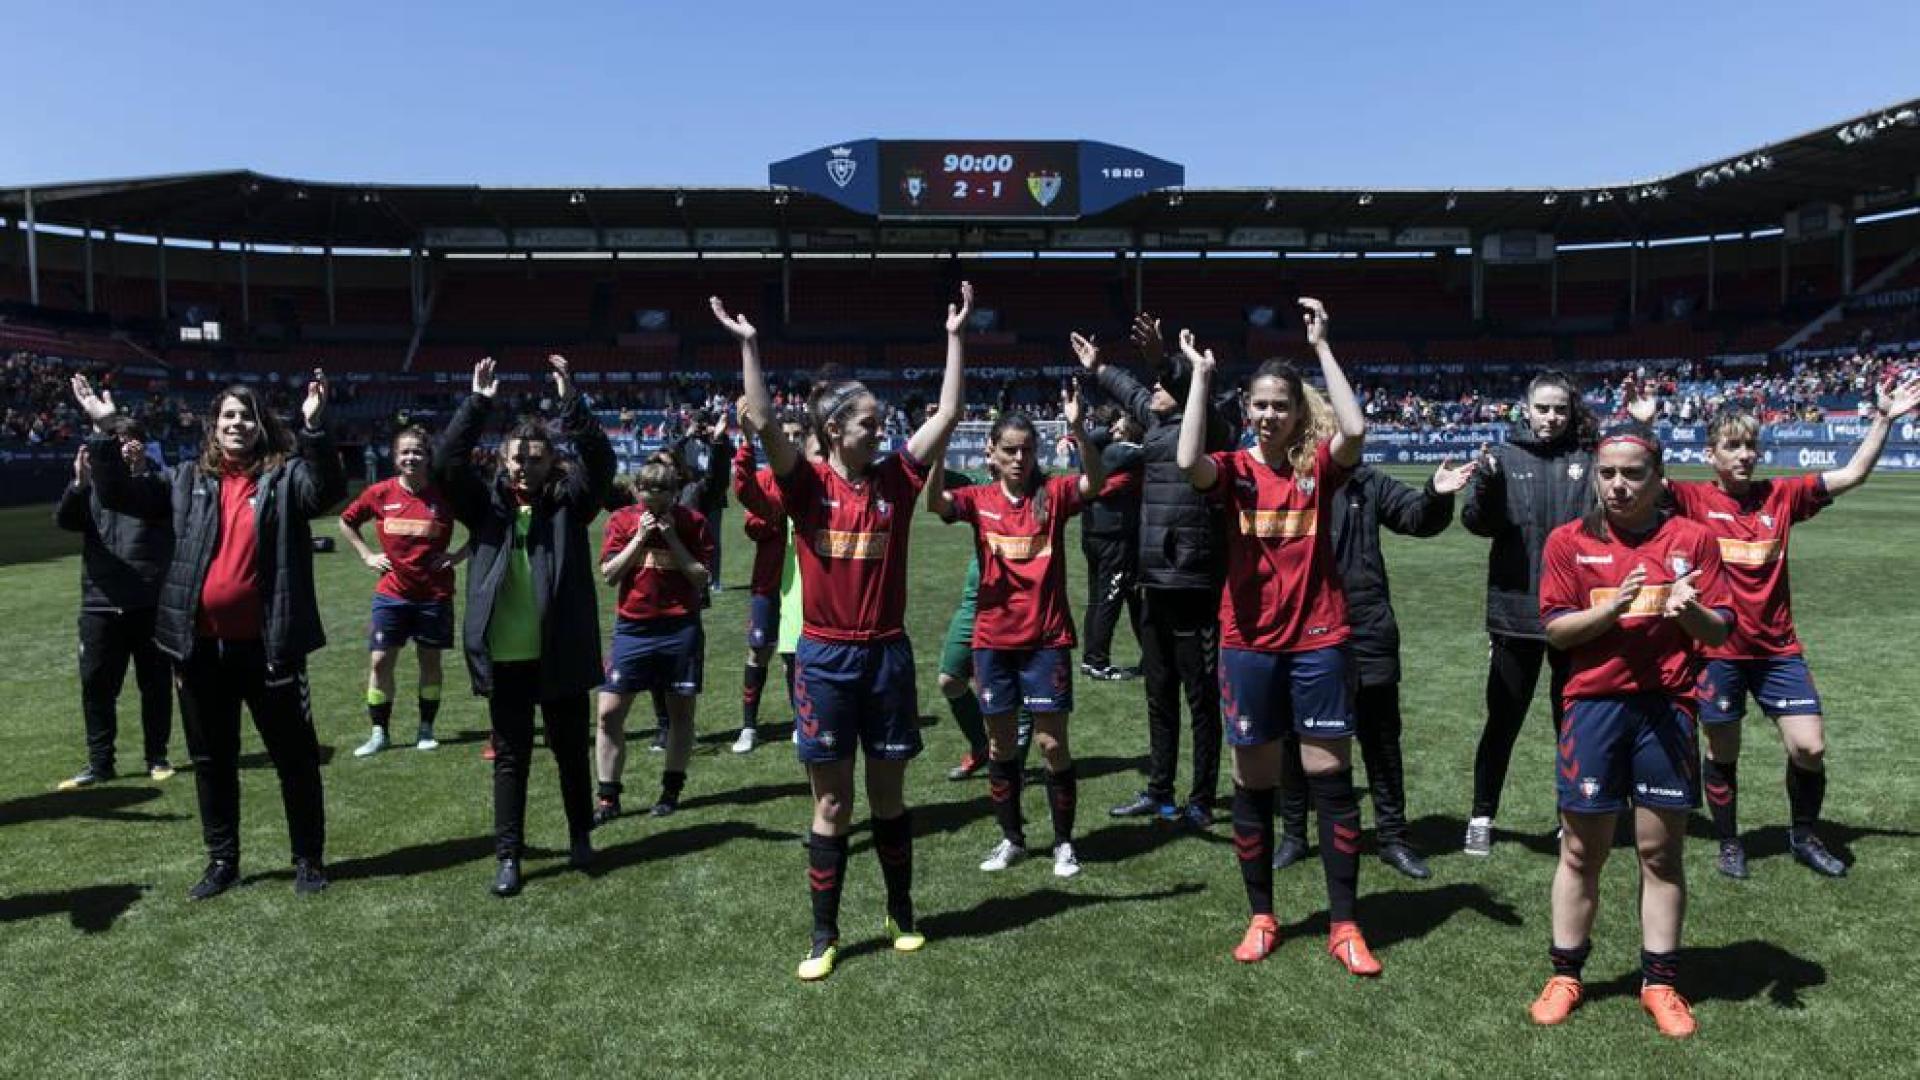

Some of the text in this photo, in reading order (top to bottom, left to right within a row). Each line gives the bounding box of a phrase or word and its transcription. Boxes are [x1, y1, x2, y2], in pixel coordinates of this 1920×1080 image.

[943, 154, 1014, 173] 90:00
[952, 180, 969, 198] 2
[991, 180, 1003, 198] 1
